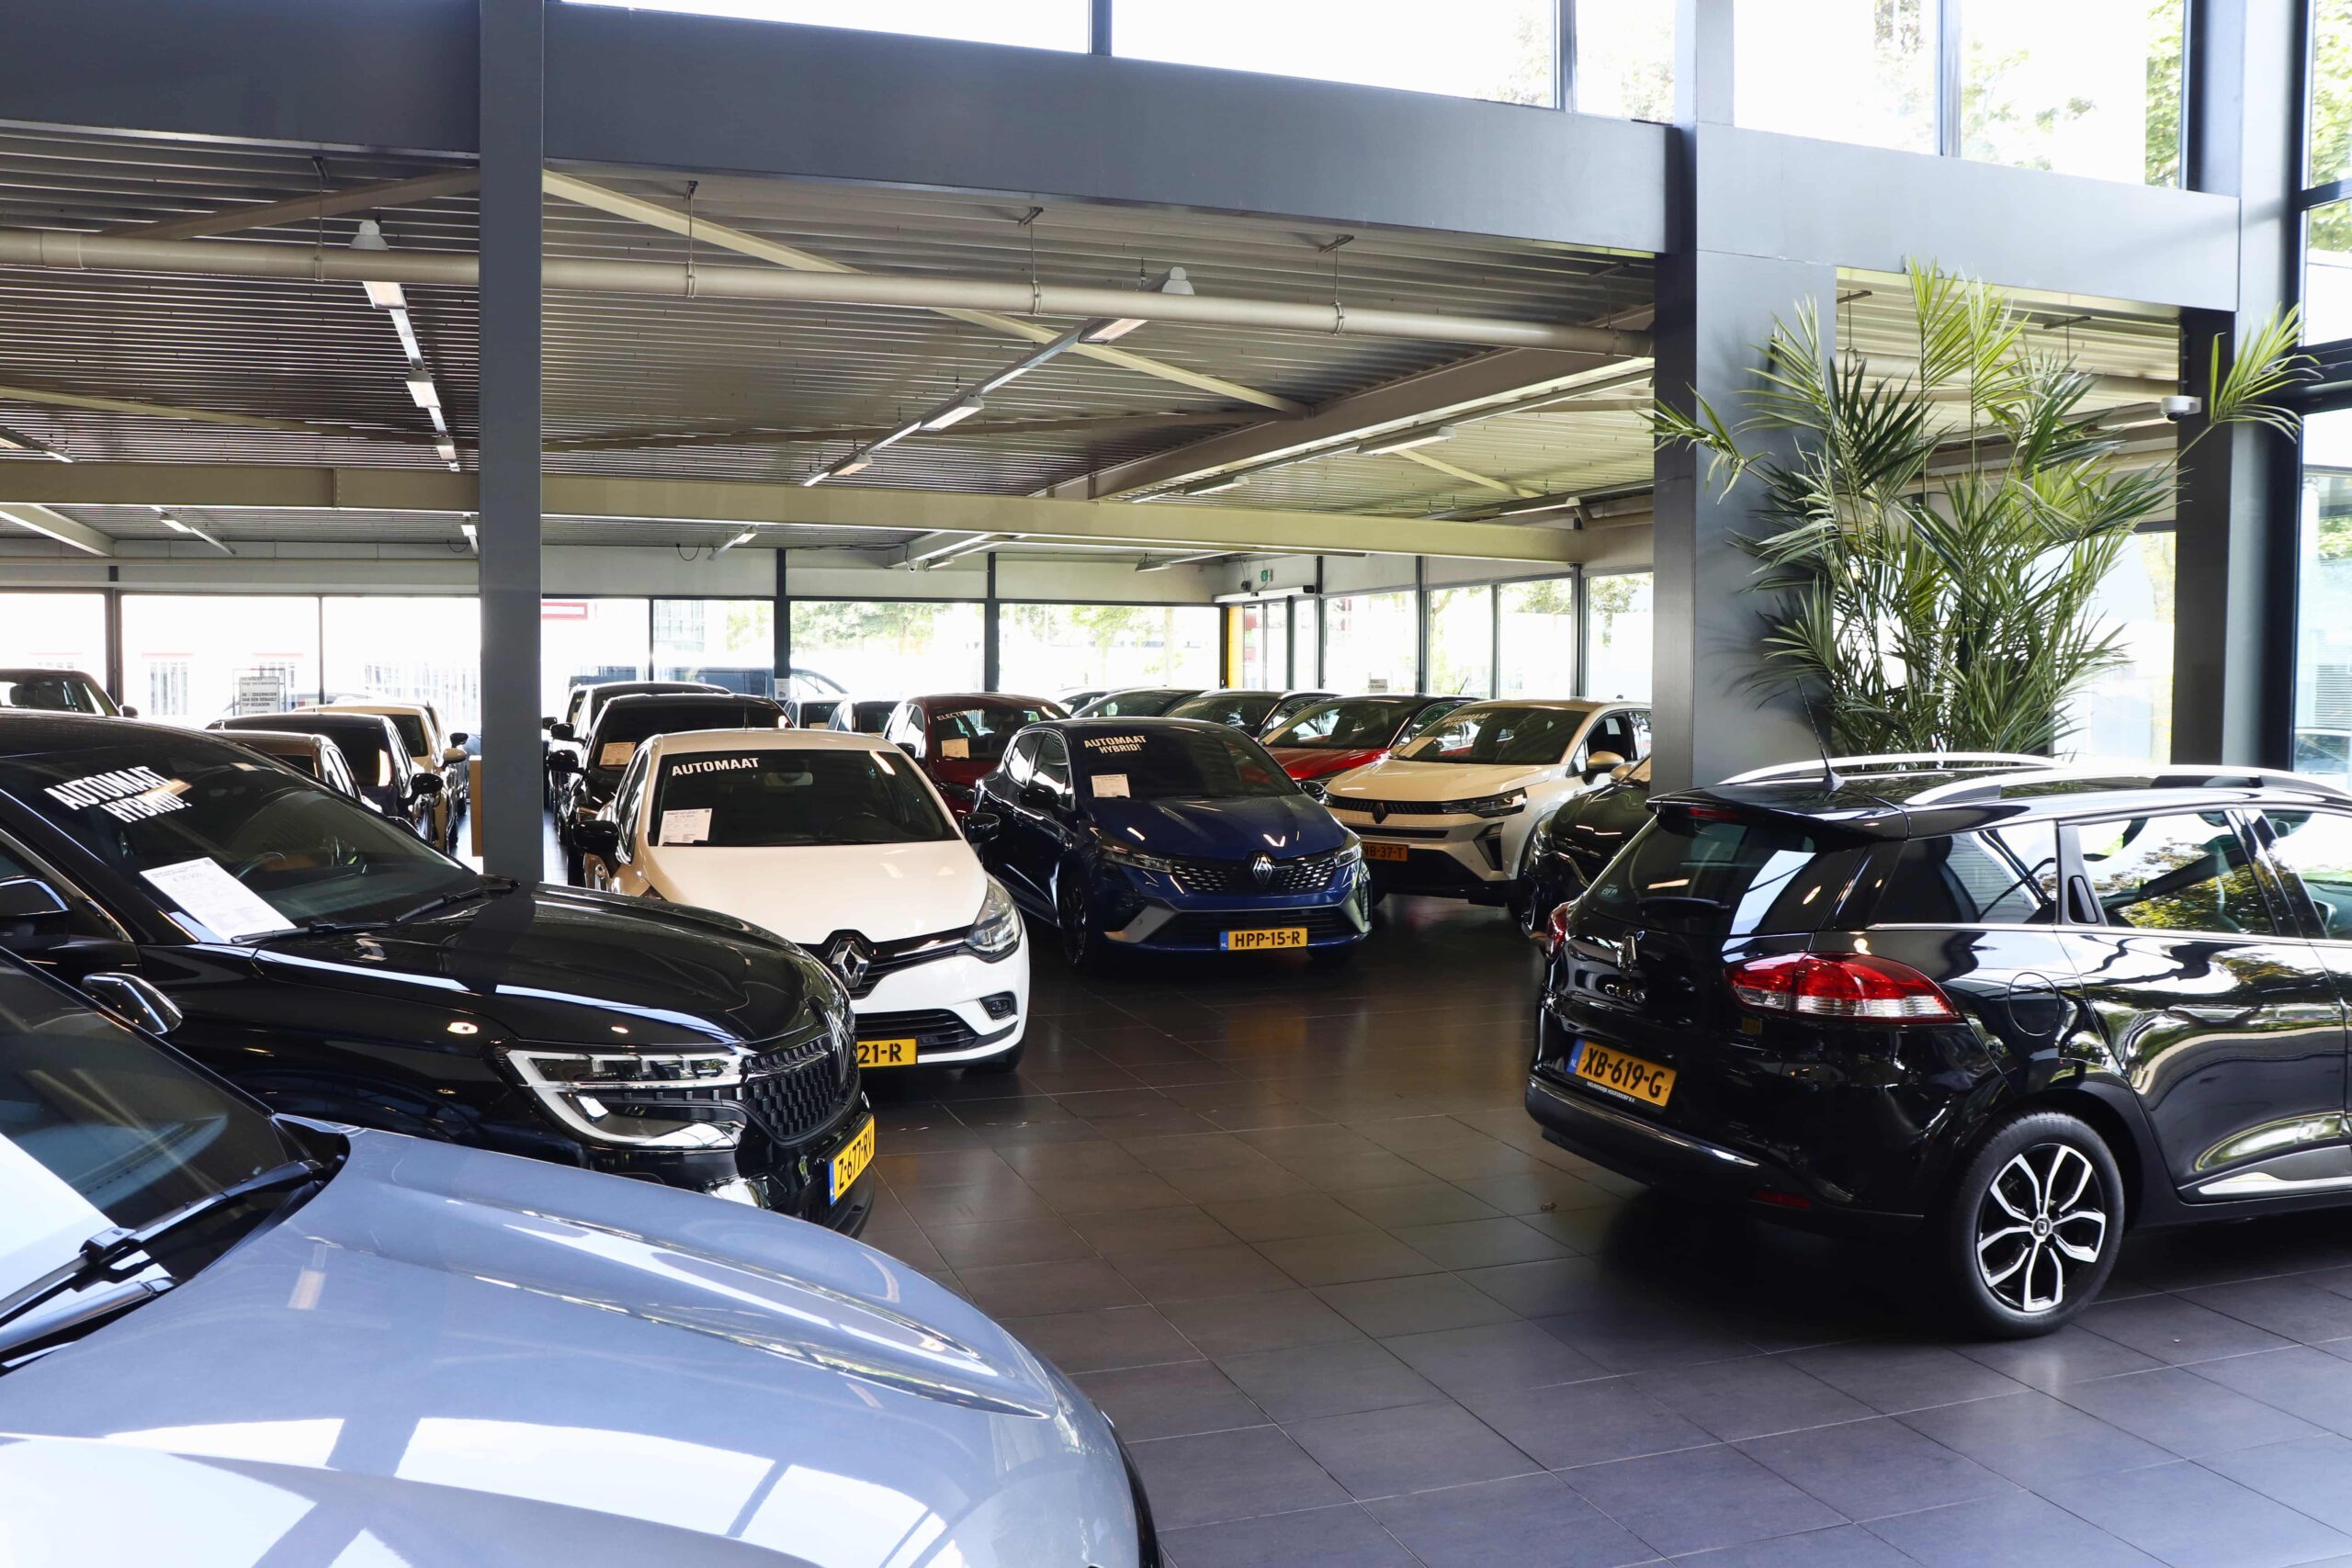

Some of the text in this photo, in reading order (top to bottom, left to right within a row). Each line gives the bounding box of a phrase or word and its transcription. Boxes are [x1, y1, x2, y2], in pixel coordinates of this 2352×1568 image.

[1083, 735, 1147, 749] AUTOMAAT
[1098, 743, 1142, 754] HYBRID!
[672, 757, 760, 777] AUTOMAAT
[43, 765, 173, 810] AUTOMAAT
[99, 790, 192, 823] HYBRID!
[1364, 843, 1404, 860] NB-37-T
[1235, 931, 1300, 948] HPP-15-R
[857, 1043, 902, 1065] 21-R
[1582, 1046, 1666, 1099] XB-619-G
[838, 1122, 873, 1190] Z-677-RV
